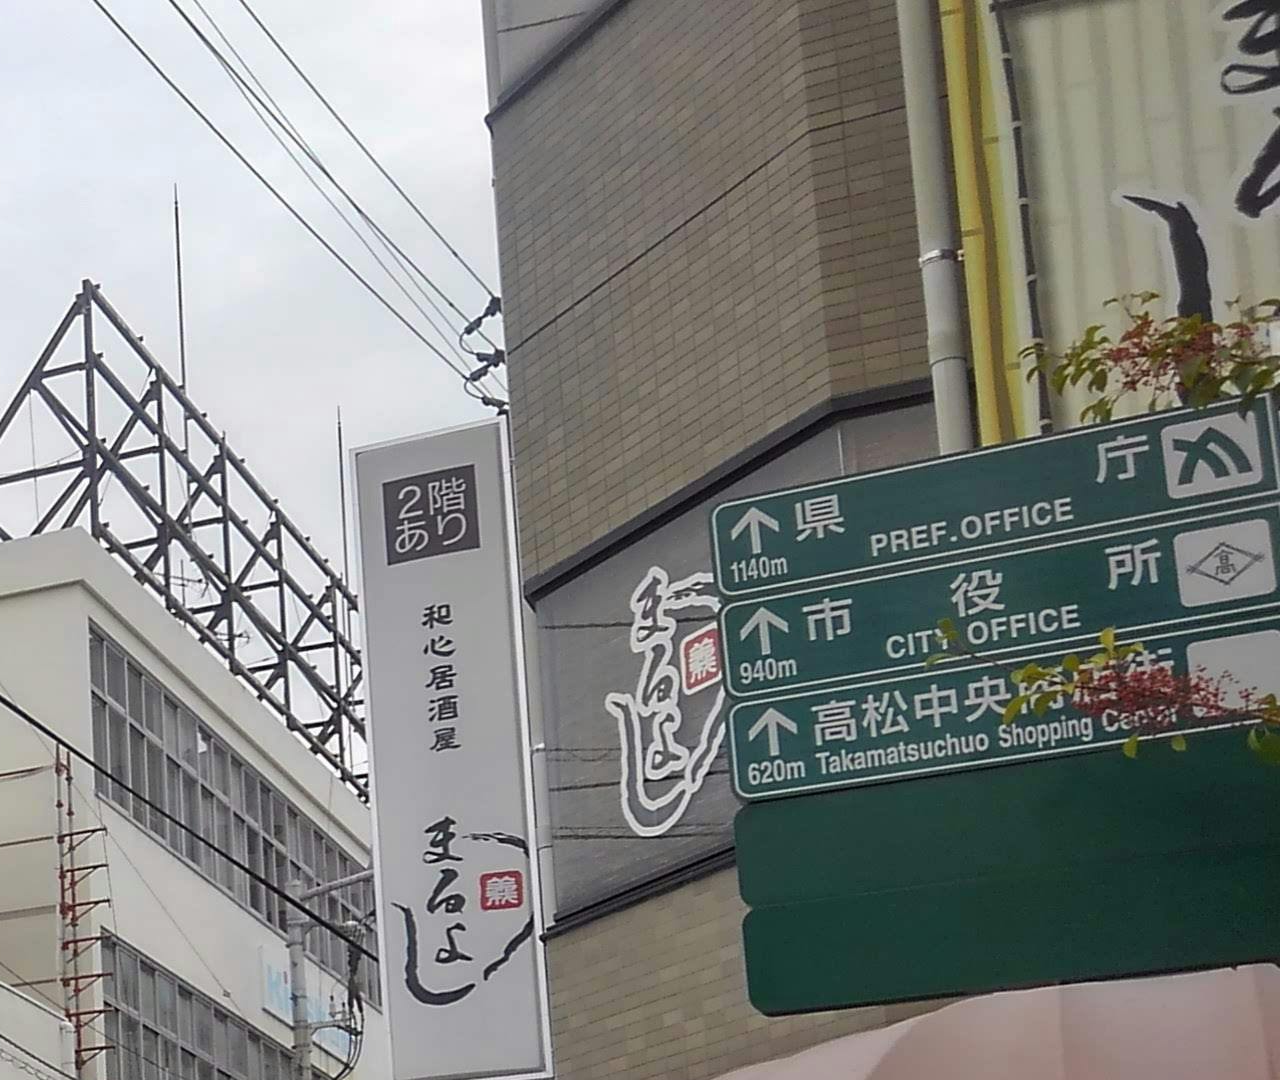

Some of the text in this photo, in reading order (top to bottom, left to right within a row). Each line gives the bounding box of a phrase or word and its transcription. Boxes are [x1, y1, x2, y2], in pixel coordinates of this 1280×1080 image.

[397, 476, 467, 520] 2階
[395, 511, 467, 554] あり
[730, 555, 788, 584] 1140m
[802, 538, 1162, 642] 市役所
[886, 604, 1082, 660] CITY OFFICE
[421, 602, 463, 753] 和心居酒屋
[740, 658, 798, 685] 940m
[810, 647, 1176, 747] 高松中央
[748, 759, 806, 786] 620m
[815, 732, 990, 776] Takamatsuchuo
[998, 715, 1094, 749] Shopping
